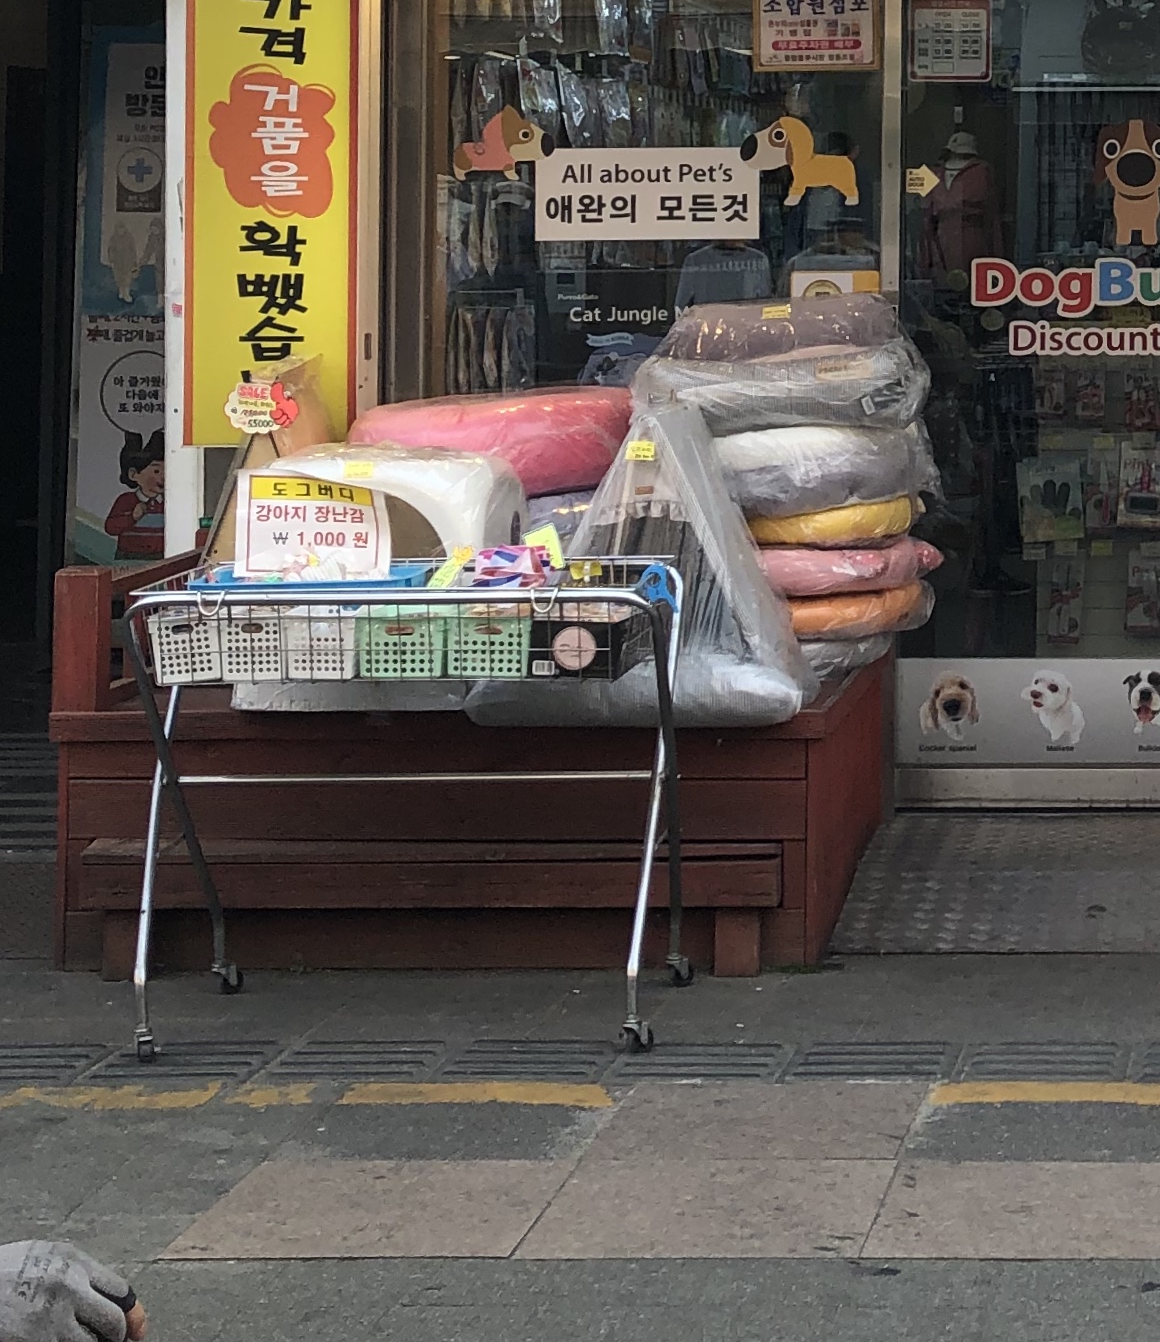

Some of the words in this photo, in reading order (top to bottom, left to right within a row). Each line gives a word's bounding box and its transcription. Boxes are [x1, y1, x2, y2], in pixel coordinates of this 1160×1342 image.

[243, 83, 310, 198] 거품을
[562, 164, 592, 183] All
[600, 164, 671, 183] about
[545, 194, 637, 224] 애완의
[656, 193, 748, 223] 모든것
[569, 306, 602, 323] Cat
[607, 306, 668, 325] Jungle
[255, 504, 307, 523] 강아지
[314, 505, 365, 524] 장난감
[296, 531, 346, 548] 1,000
[352, 531, 369, 549] 원
